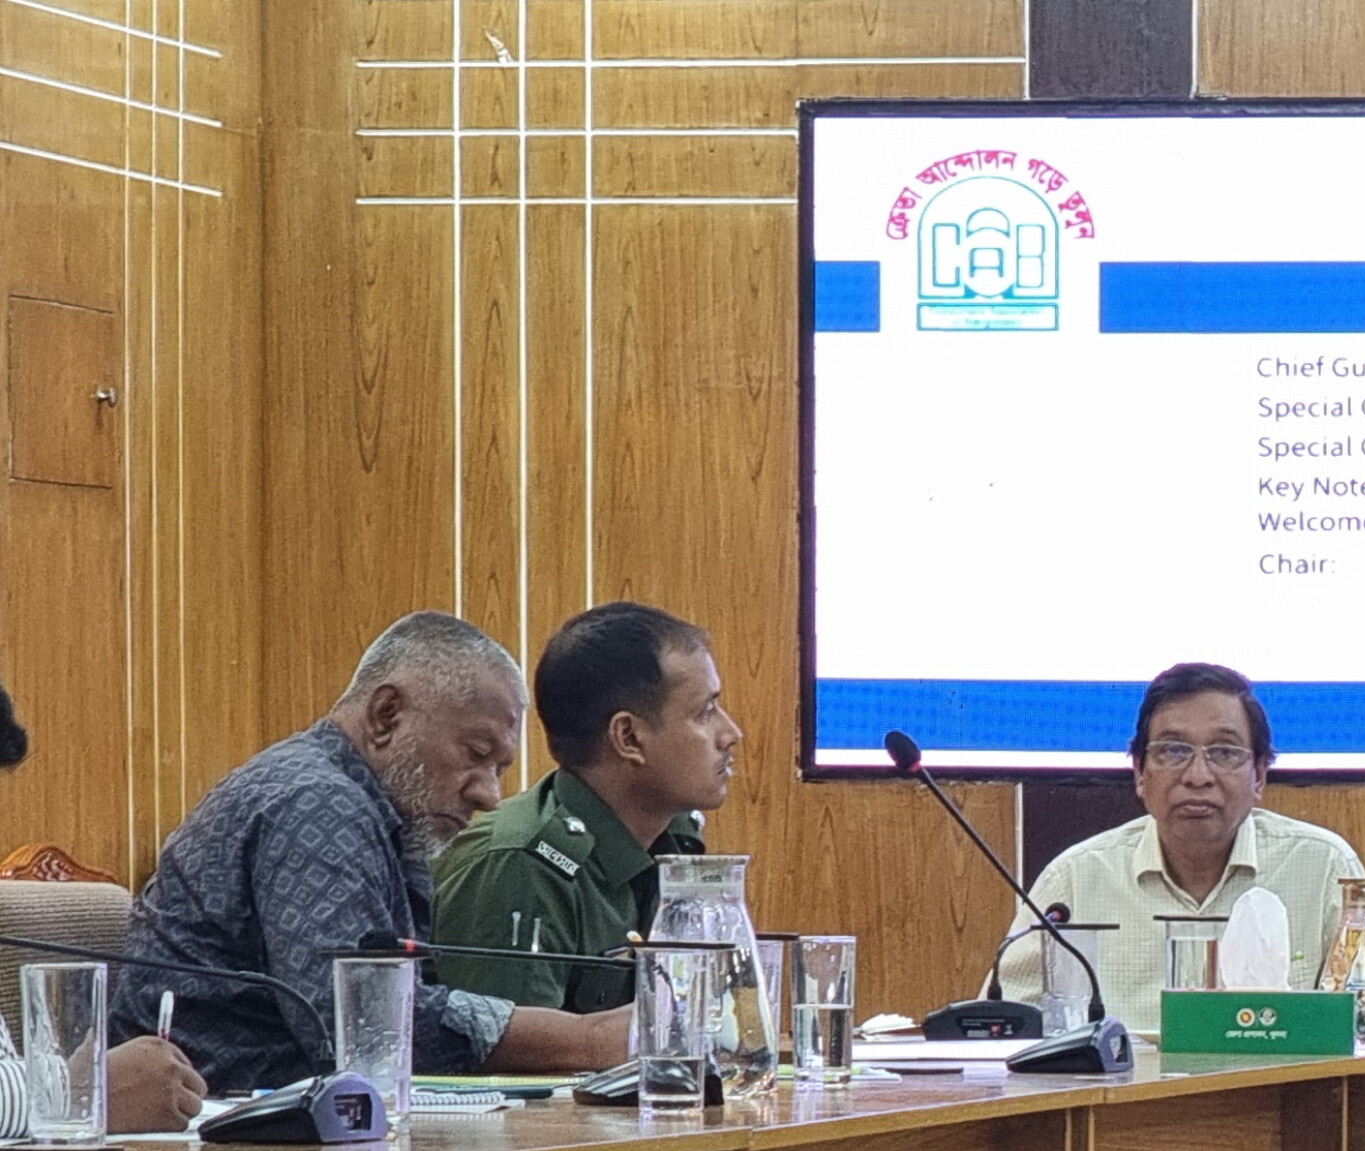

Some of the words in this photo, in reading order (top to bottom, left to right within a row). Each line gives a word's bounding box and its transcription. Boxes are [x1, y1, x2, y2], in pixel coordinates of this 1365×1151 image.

[1256, 355, 1324, 378] Chief
[1258, 396, 1352, 422] Special
[1258, 435, 1352, 463] Special
[1258, 477, 1305, 502] Key
[1259, 553, 1335, 575] Chair:
